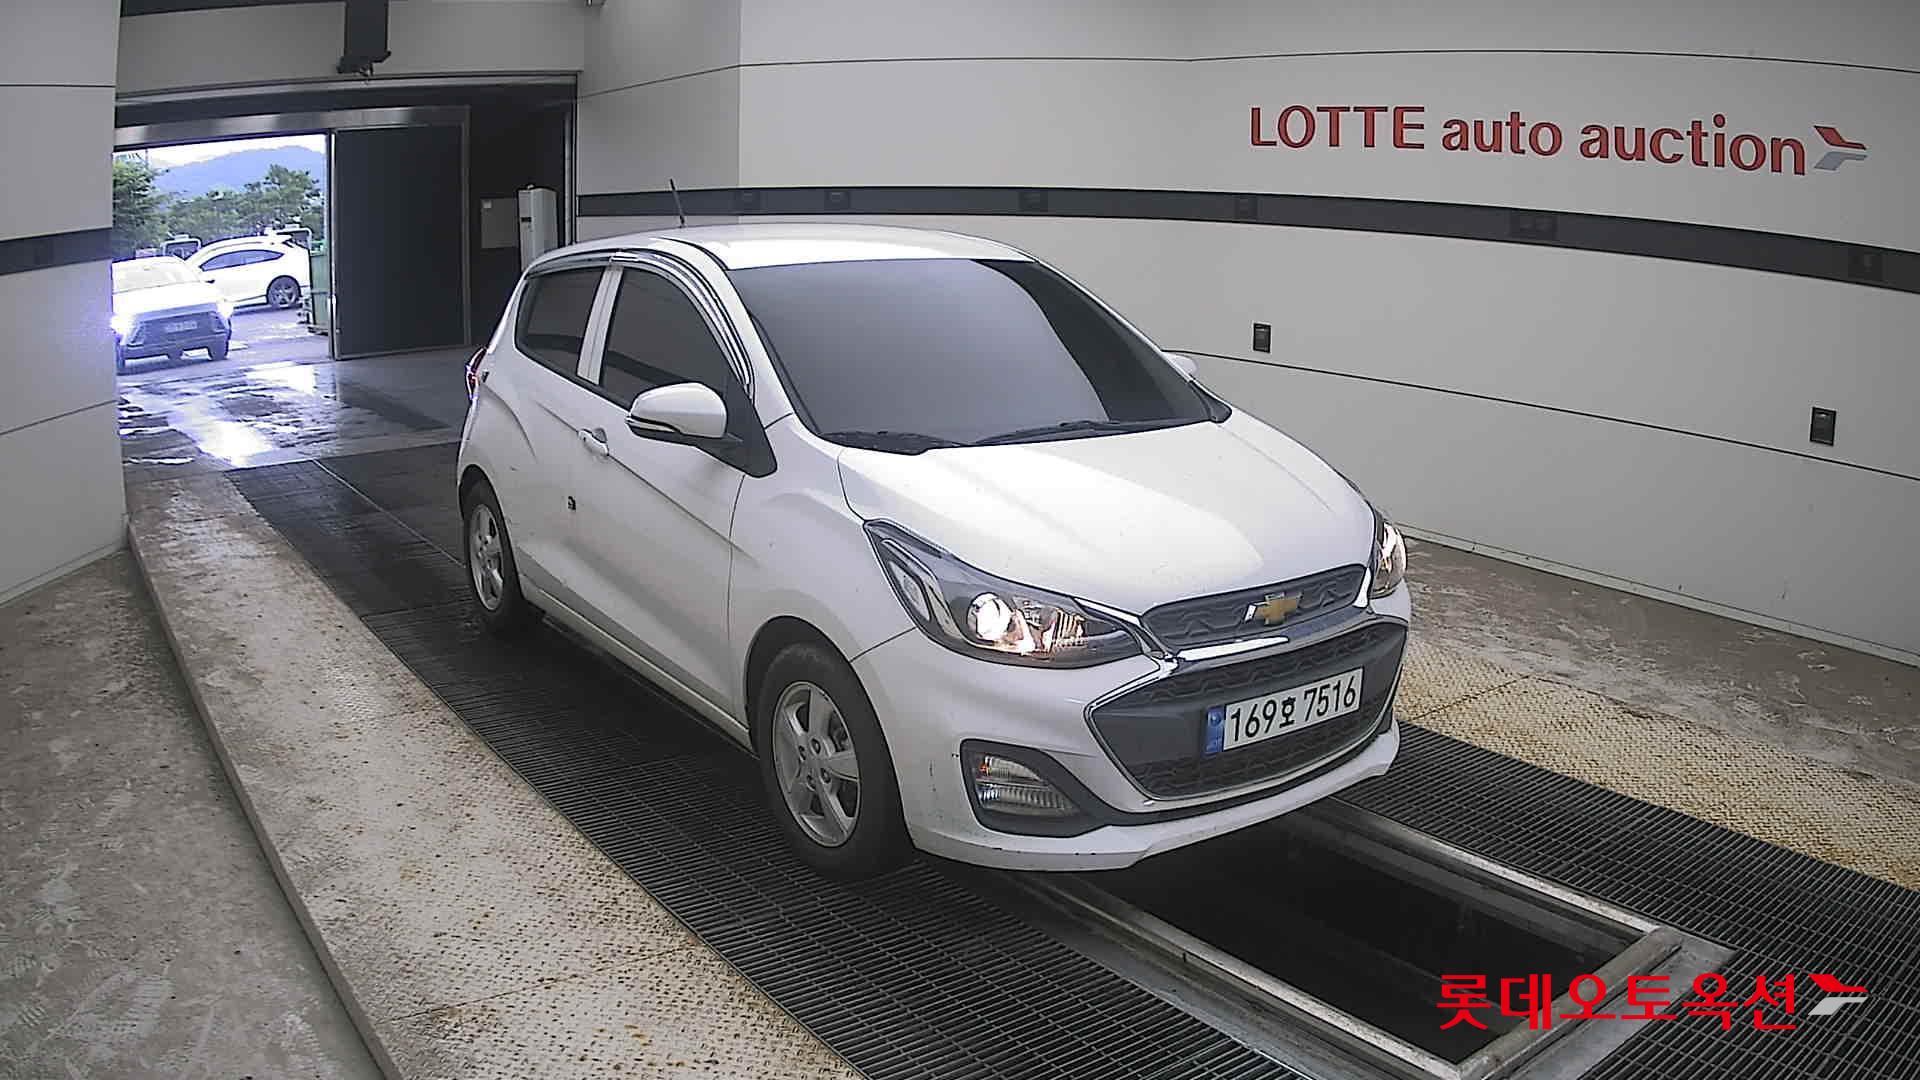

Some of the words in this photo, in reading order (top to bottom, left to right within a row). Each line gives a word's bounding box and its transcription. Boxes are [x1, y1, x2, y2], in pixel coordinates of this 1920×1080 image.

[1250, 105, 1425, 150] LOTTE
[1441, 111, 1563, 157] auto
[1579, 114, 1807, 176] auction
[1230, 696, 1297, 741] 169호
[1303, 675, 1356, 722] 7516
